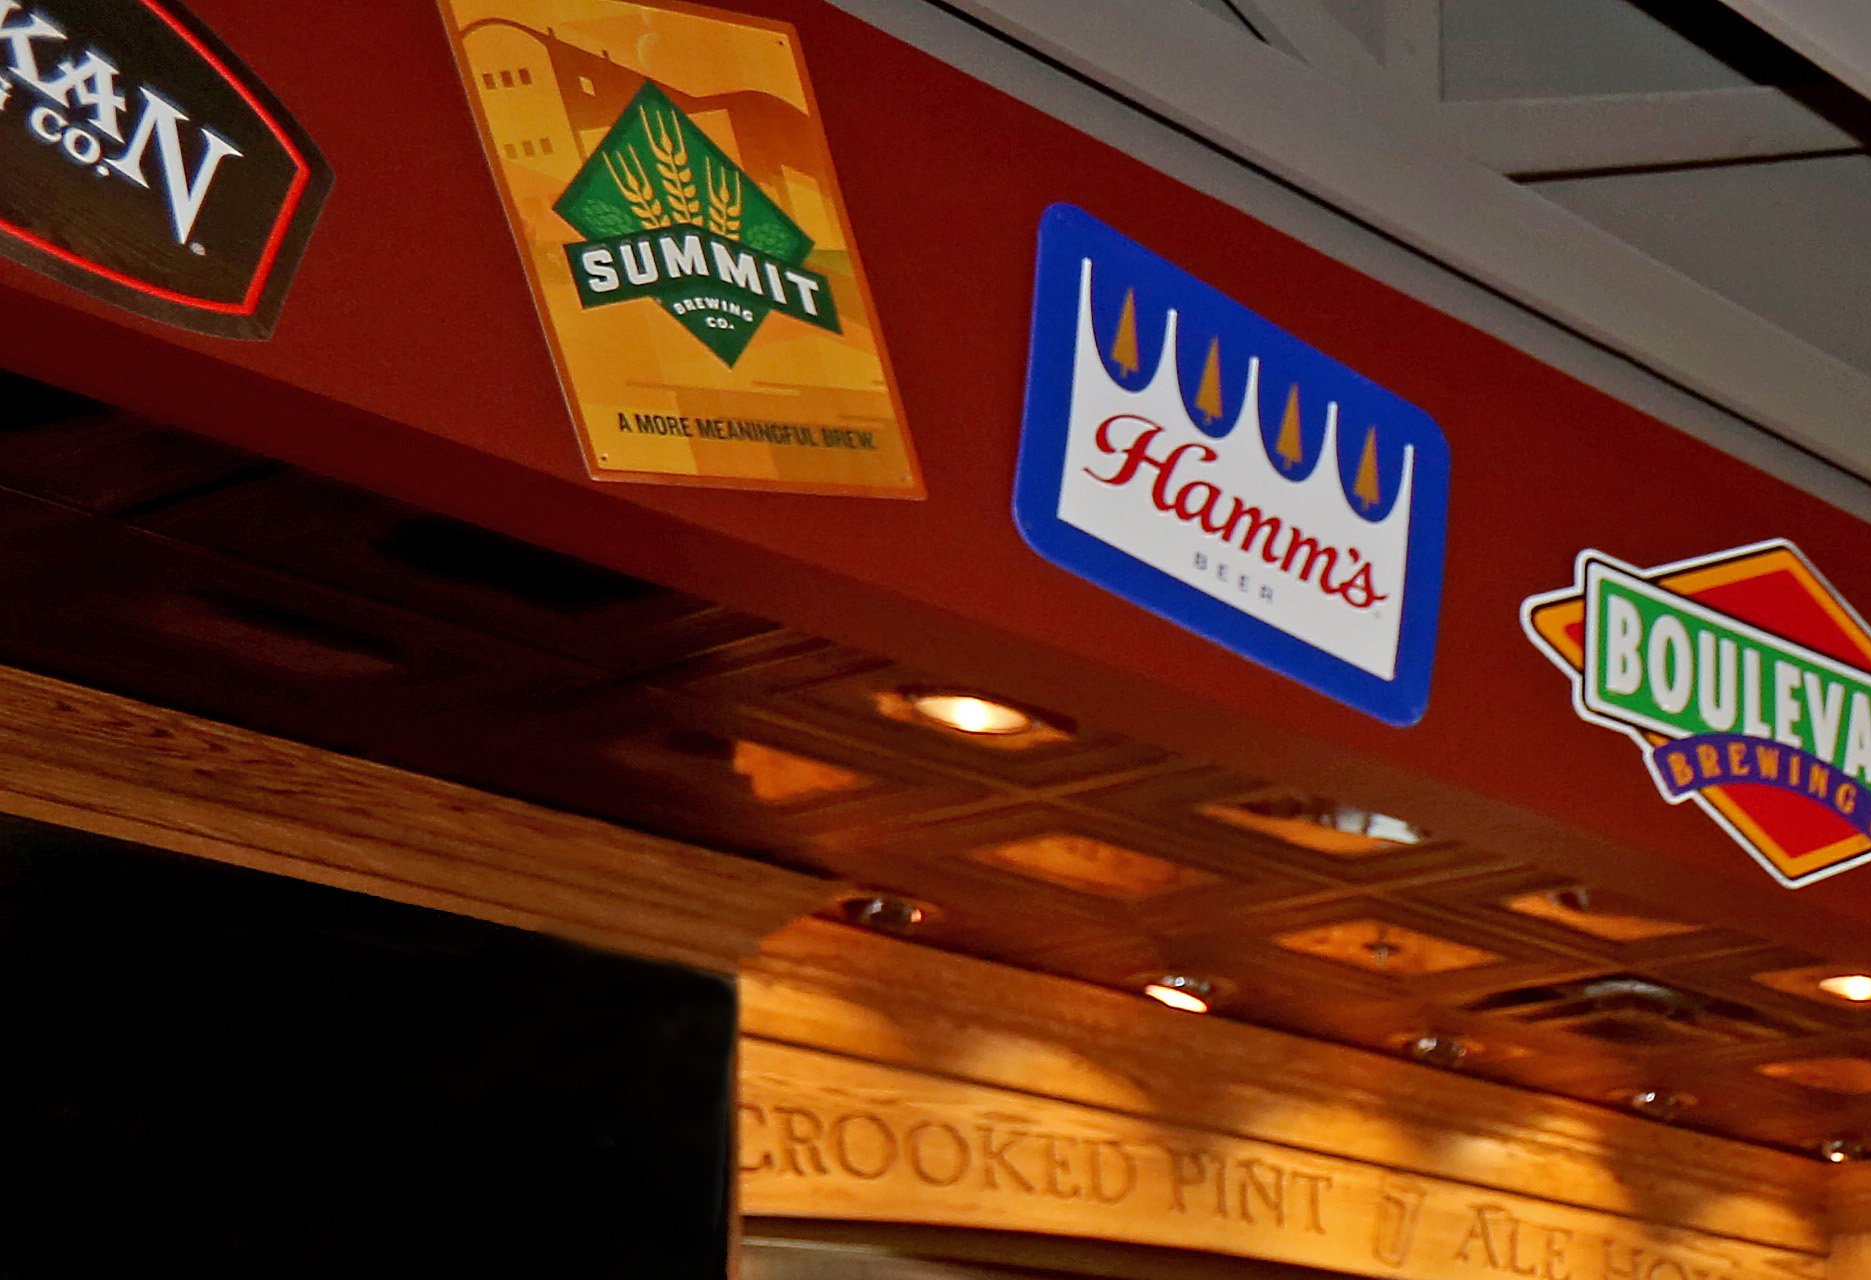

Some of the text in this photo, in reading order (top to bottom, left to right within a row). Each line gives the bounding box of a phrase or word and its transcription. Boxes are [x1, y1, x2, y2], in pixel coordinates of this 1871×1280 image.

[29, 105, 110, 177] CO.
[581, 234, 820, 317] SUMMIT
[672, 297, 753, 323] BREWING
[705, 316, 735, 330] CO.
[617, 412, 632, 432] A
[635, 413, 693, 437] MORE
[695, 417, 817, 447] MEANINGFUL
[1082, 411, 1387, 611] Hamm's
[1193, 551, 1275, 606] BEER
[1667, 742, 1857, 814] BREWING
[740, 1101, 1127, 1203] CROOKED
[1167, 1144, 1338, 1237] PINT
